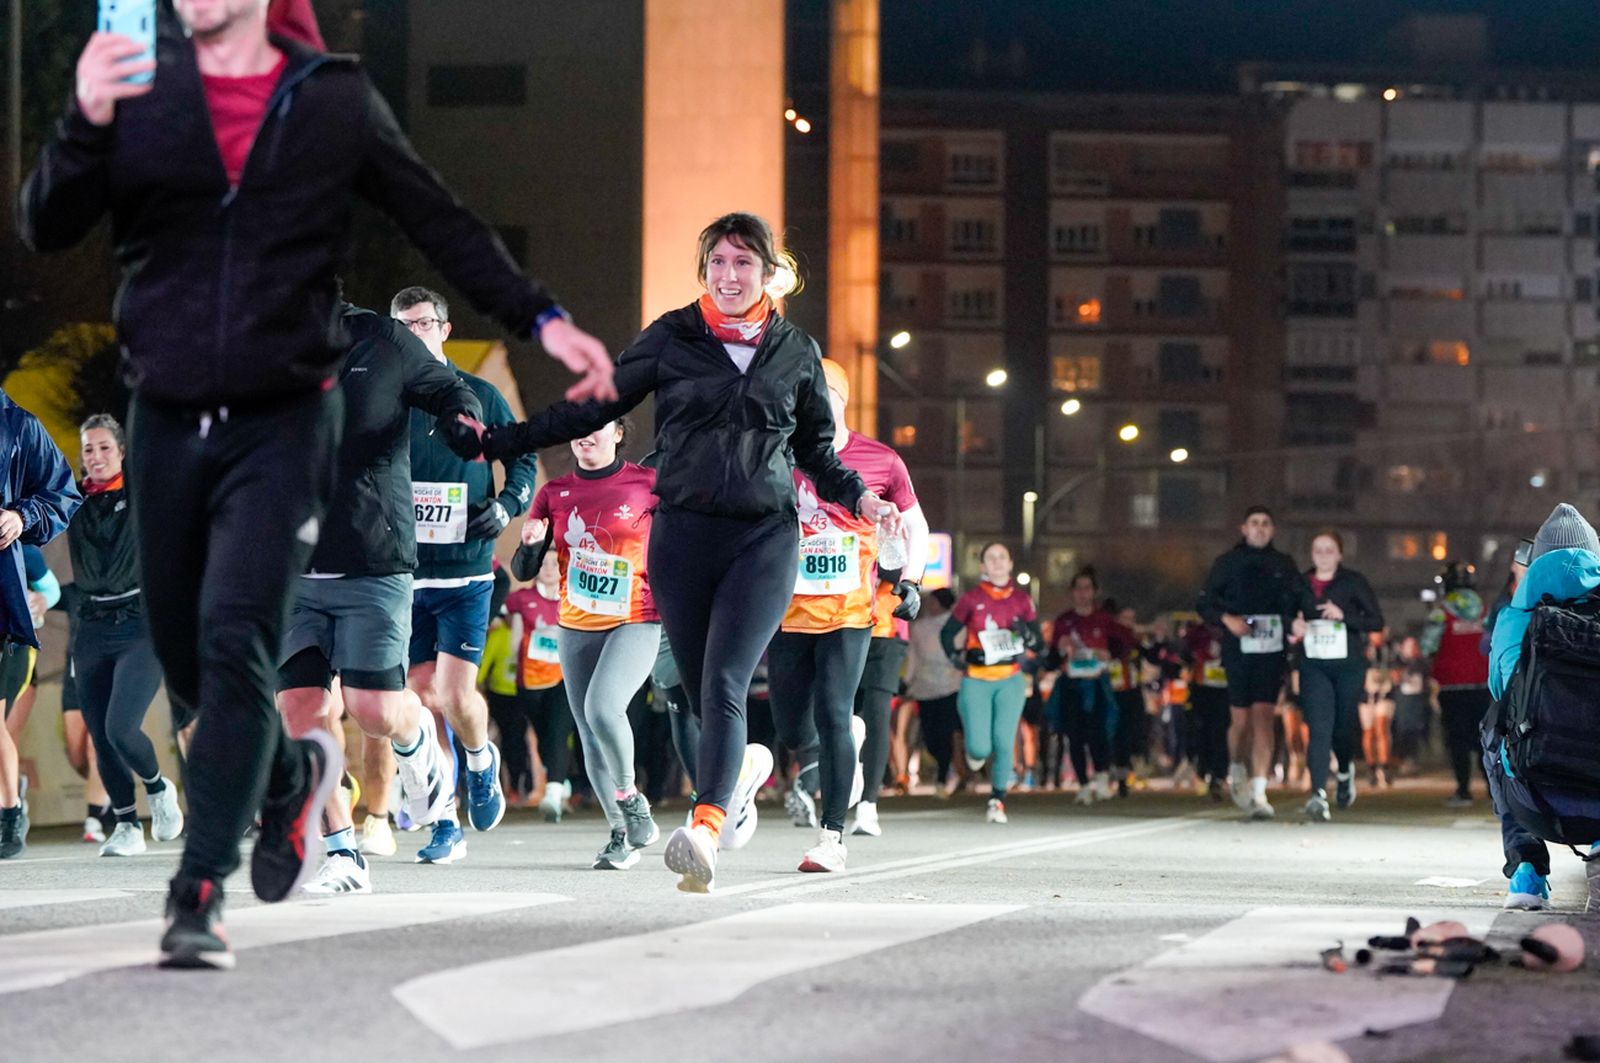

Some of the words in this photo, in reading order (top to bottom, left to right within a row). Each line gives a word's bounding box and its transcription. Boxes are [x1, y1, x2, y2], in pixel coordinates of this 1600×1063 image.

[414, 504, 452, 522] 6277
[806, 555, 846, 574] 8918
[579, 570, 618, 596] 9027
